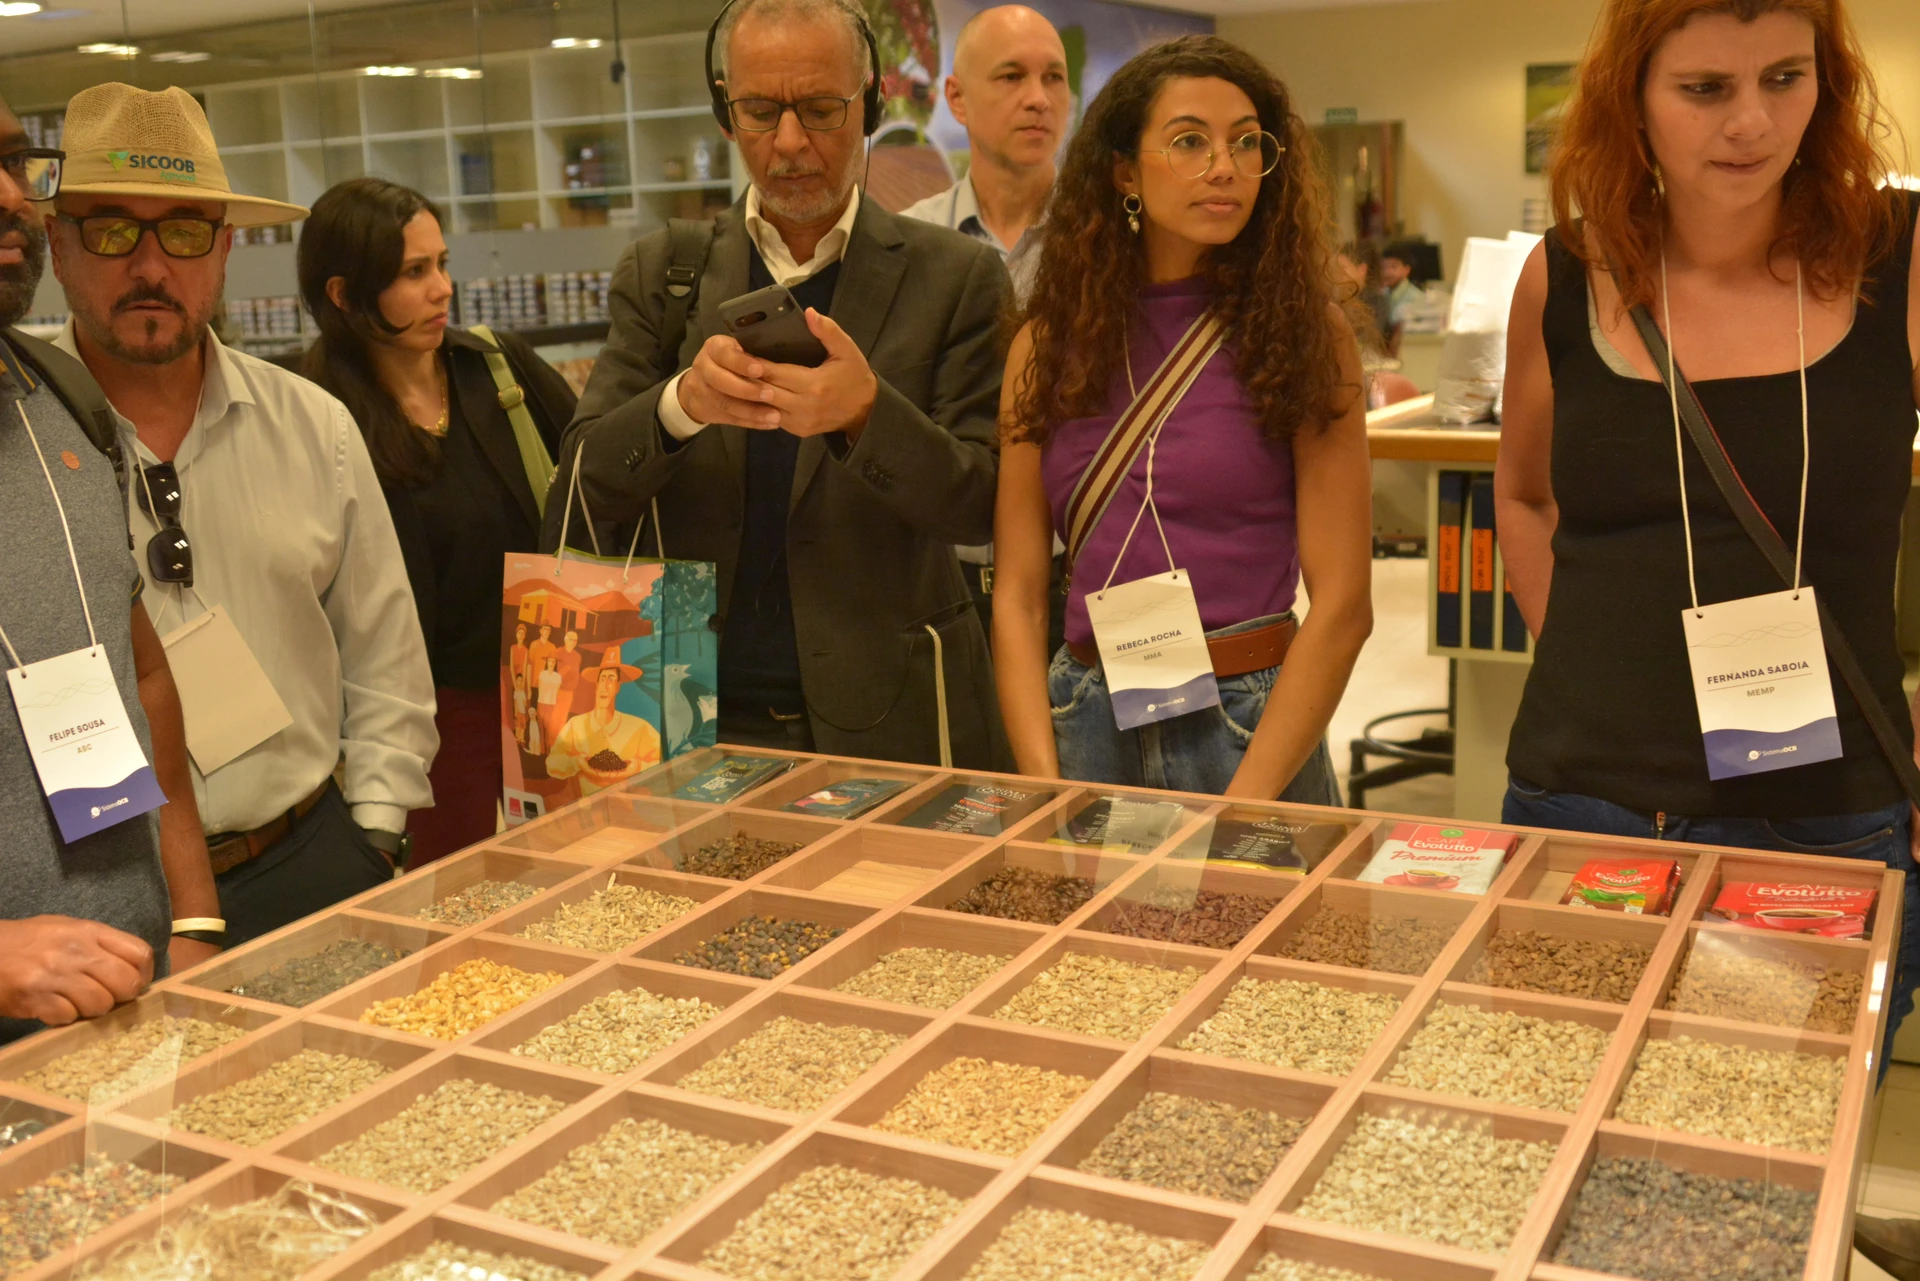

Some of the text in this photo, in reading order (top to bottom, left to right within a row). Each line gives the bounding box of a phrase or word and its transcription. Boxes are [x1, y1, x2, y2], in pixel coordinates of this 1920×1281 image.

[129, 154, 195, 173] SICOOB
[1116, 629, 1182, 652] REBECA ROCHA
[1143, 651, 1163, 661] MMA
[1707, 660, 1810, 685] FERNANDA SABOIA
[1746, 686, 1775, 698] MEMP
[49, 718, 106, 742] FELIPE SOUSA
[77, 743, 93, 754] ABC
[1762, 745, 1797, 757] SistemaOCB
[1413, 840, 1475, 852] Evolutto
[1390, 850, 1486, 862] Premium
[1595, 872, 1651, 884] Evolutto
[1757, 887, 1862, 898] Evolutto
